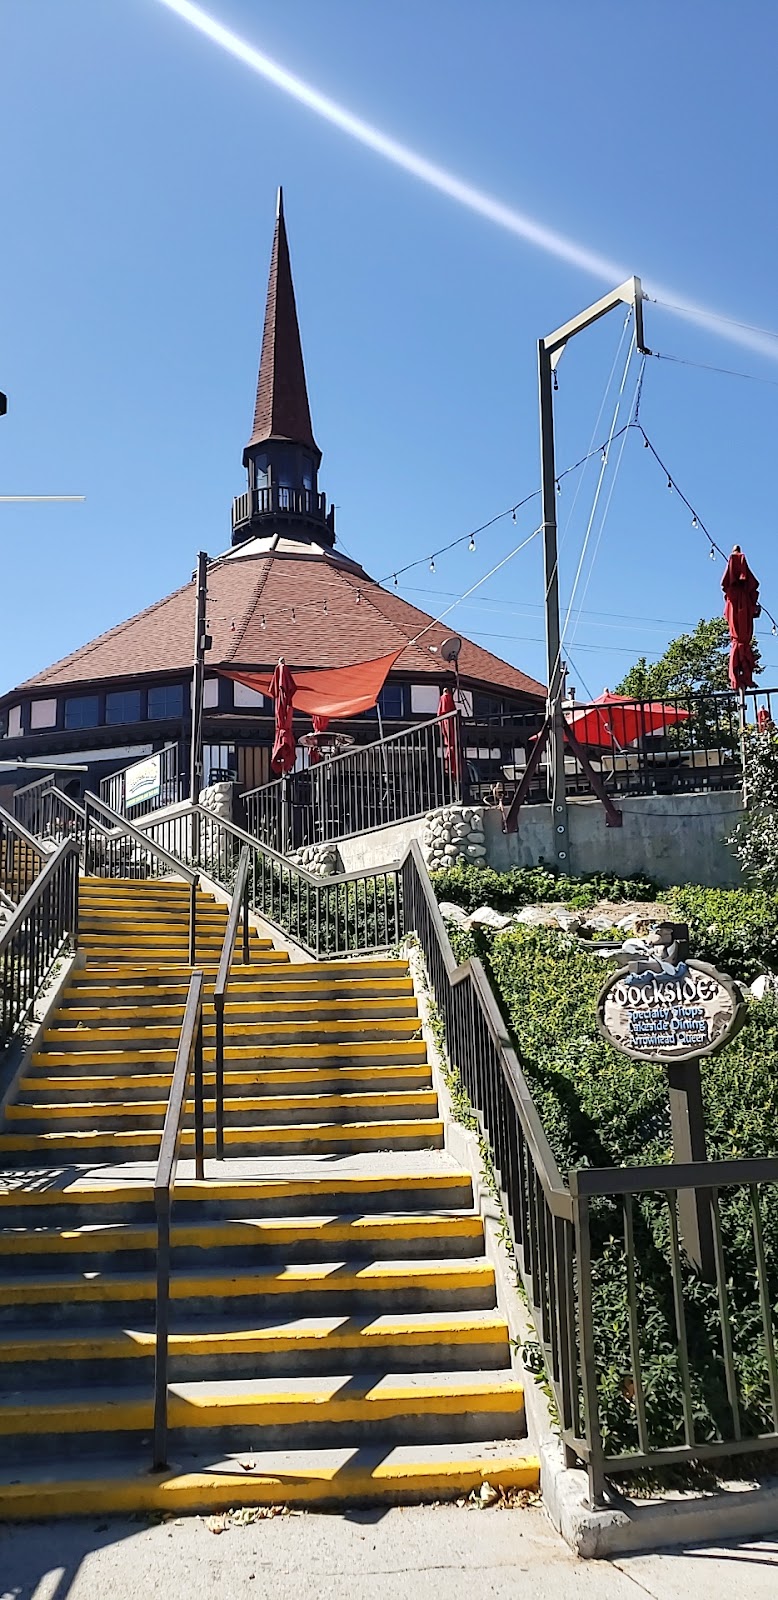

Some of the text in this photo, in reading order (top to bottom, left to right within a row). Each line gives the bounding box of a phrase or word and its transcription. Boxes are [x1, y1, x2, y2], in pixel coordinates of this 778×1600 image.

[627, 1005, 704, 1022] Specialty Shops
[627, 1018, 706, 1033] Lakeside Dining
[629, 1034, 675, 1046] Arrowhead
